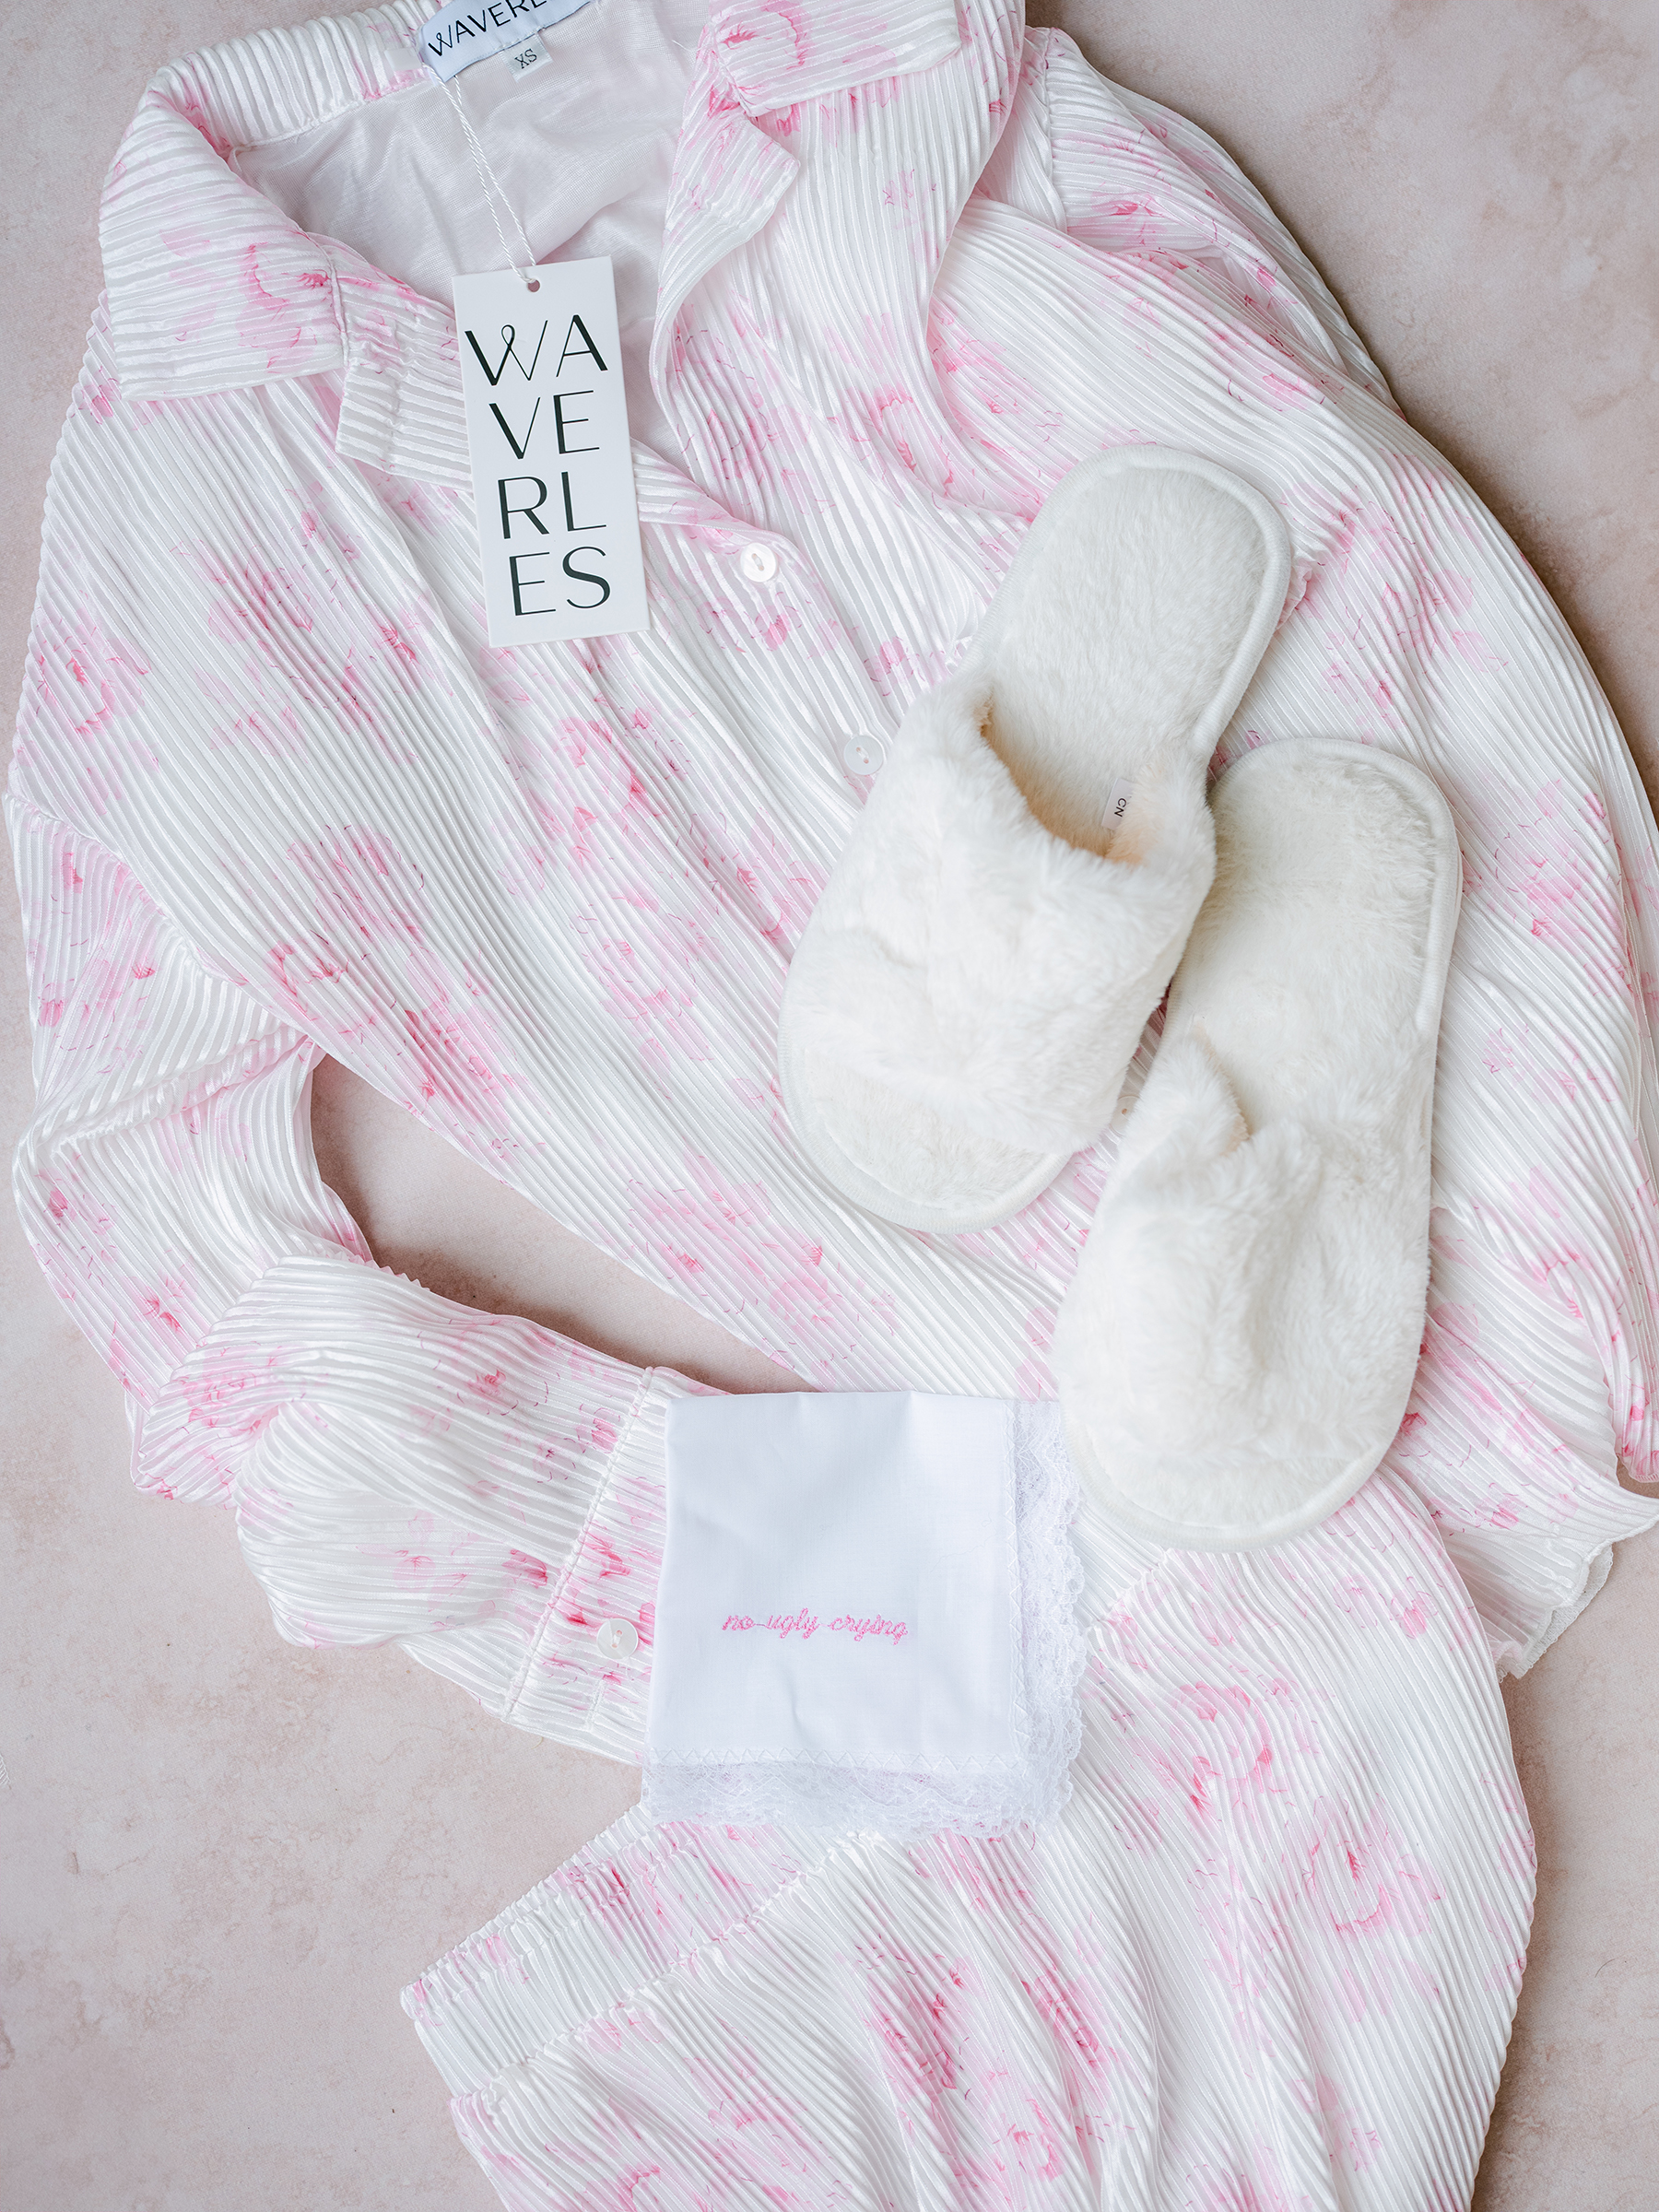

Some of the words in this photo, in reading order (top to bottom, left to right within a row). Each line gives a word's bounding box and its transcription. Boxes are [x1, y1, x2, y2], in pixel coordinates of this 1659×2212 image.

[514, 48, 537, 69] XS
[464, 314, 608, 386] WA
[488, 389, 600, 460] VE
[498, 471, 607, 539] RL
[509, 546, 612, 617] ES
[1113, 797, 1127, 818] CN
[722, 1615, 756, 1631] no
[765, 1607, 819, 1640] ugly
[828, 1614, 909, 1646] crying
